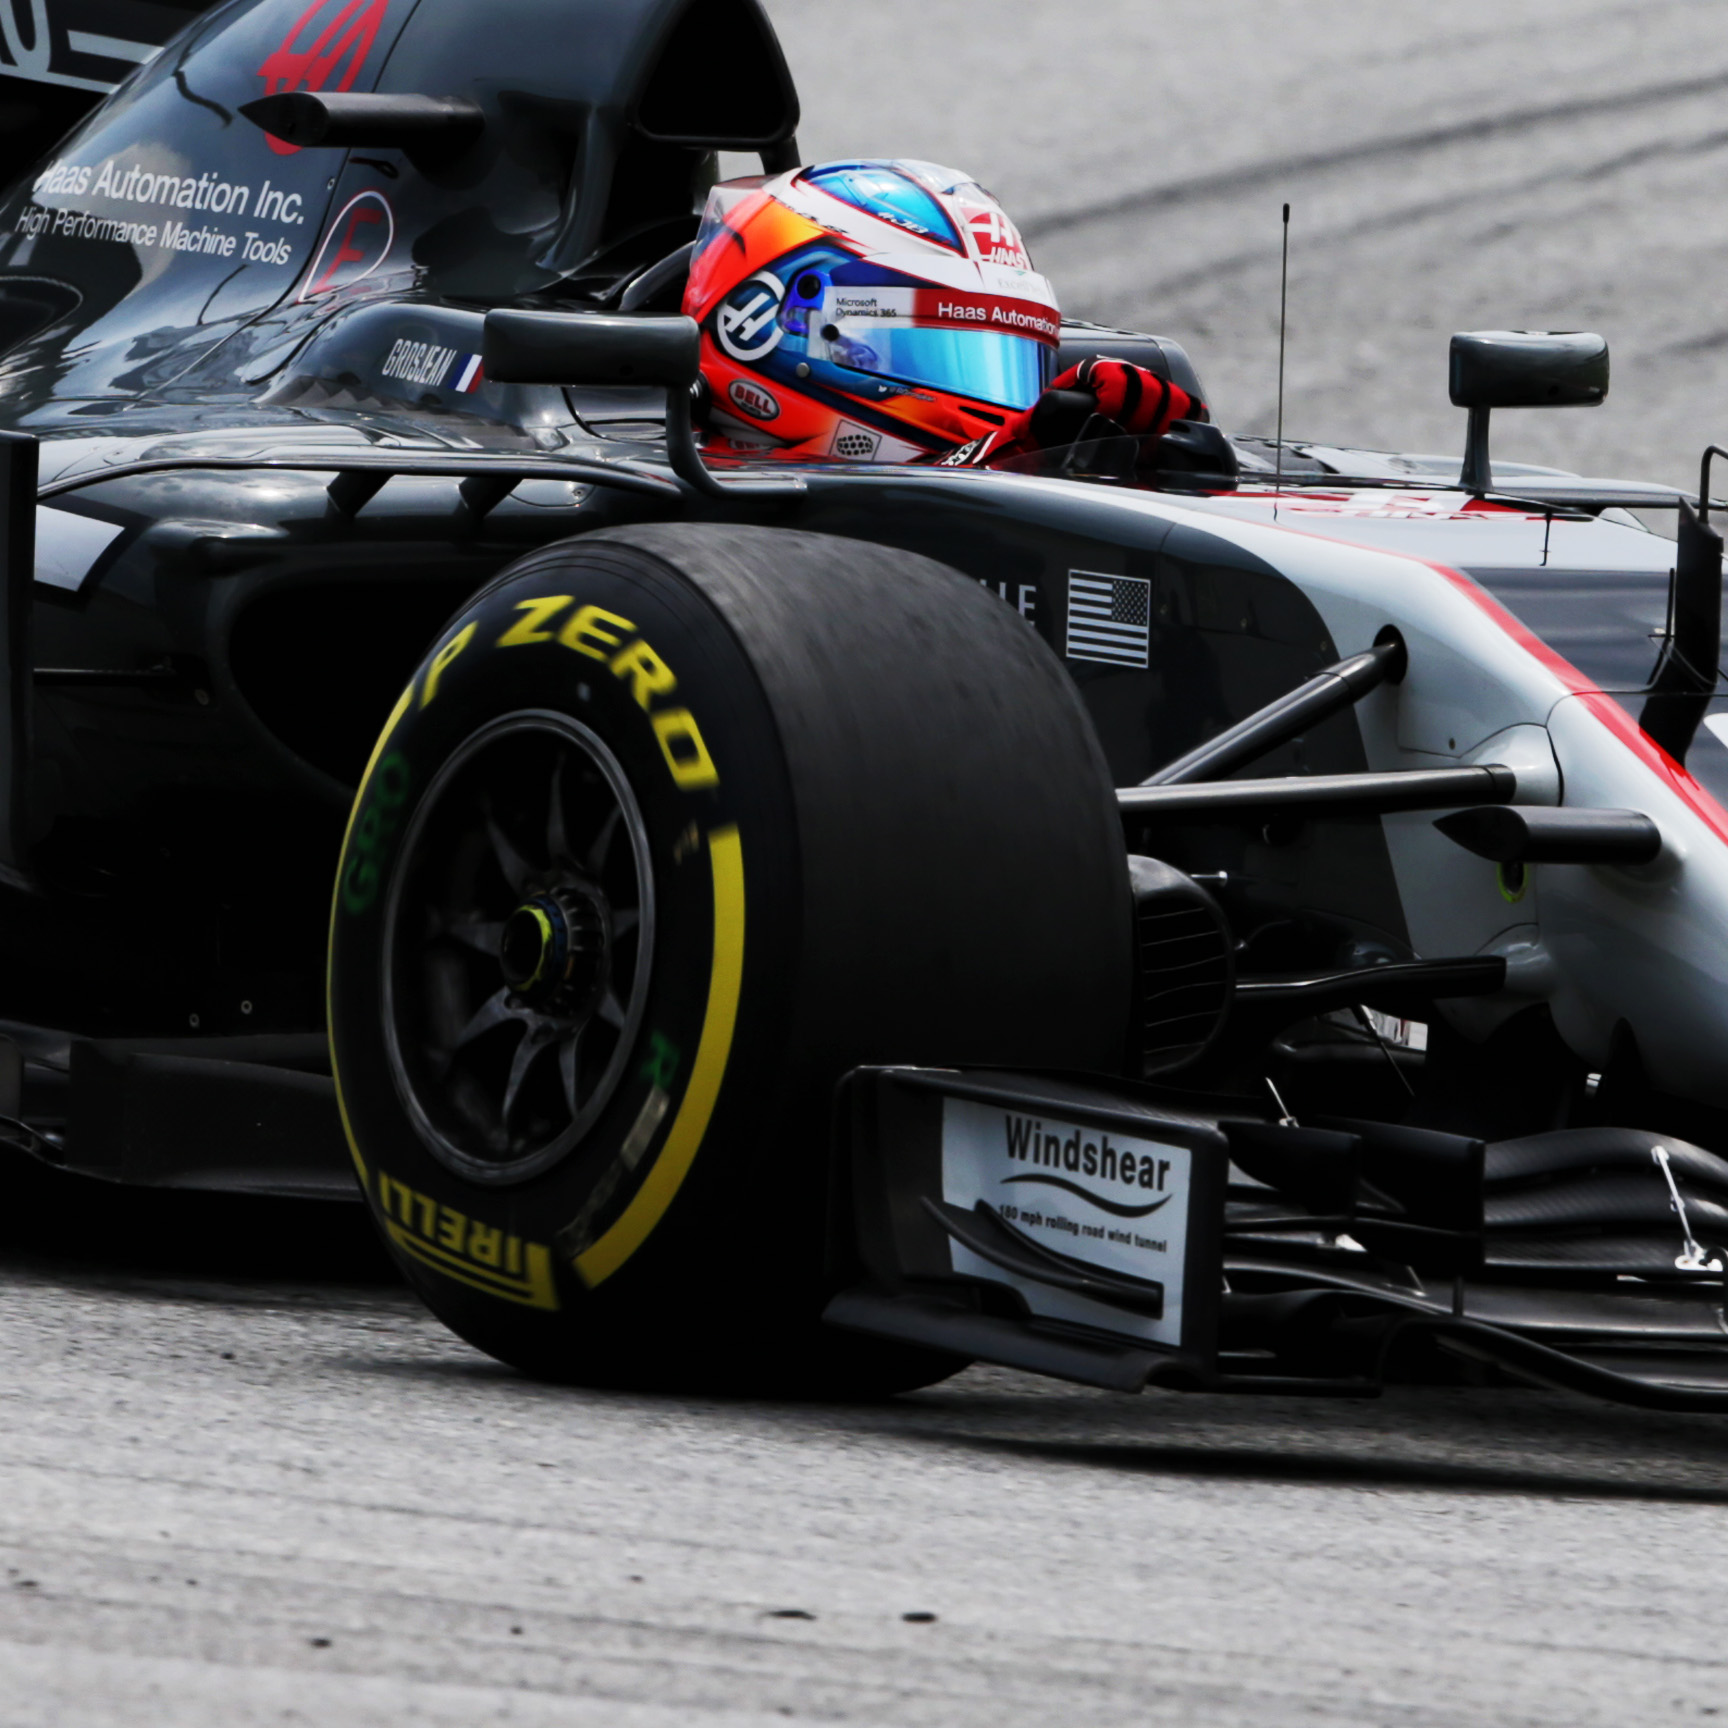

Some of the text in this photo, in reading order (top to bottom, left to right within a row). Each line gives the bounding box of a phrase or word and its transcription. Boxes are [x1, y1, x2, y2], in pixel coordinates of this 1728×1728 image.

[33, 160, 304, 225] Haas Automation Inc.
[15, 206, 292, 265] High Performance Machine Tools
[835, 308, 897, 319] Dynamics 365
[836, 298, 877, 308] Microsoft
[938, 302, 1057, 335] Haas Automation
[382, 338, 457, 386] GROSJEAN
[734, 384, 772, 415] BELL
[419, 594, 721, 792] P ZERO
[1005, 1114, 1170, 1192] Windshear
[376, 1167, 563, 1313] PIRELLI
[999, 1203, 1167, 1253] 180 mph rolling road wind tunnel
